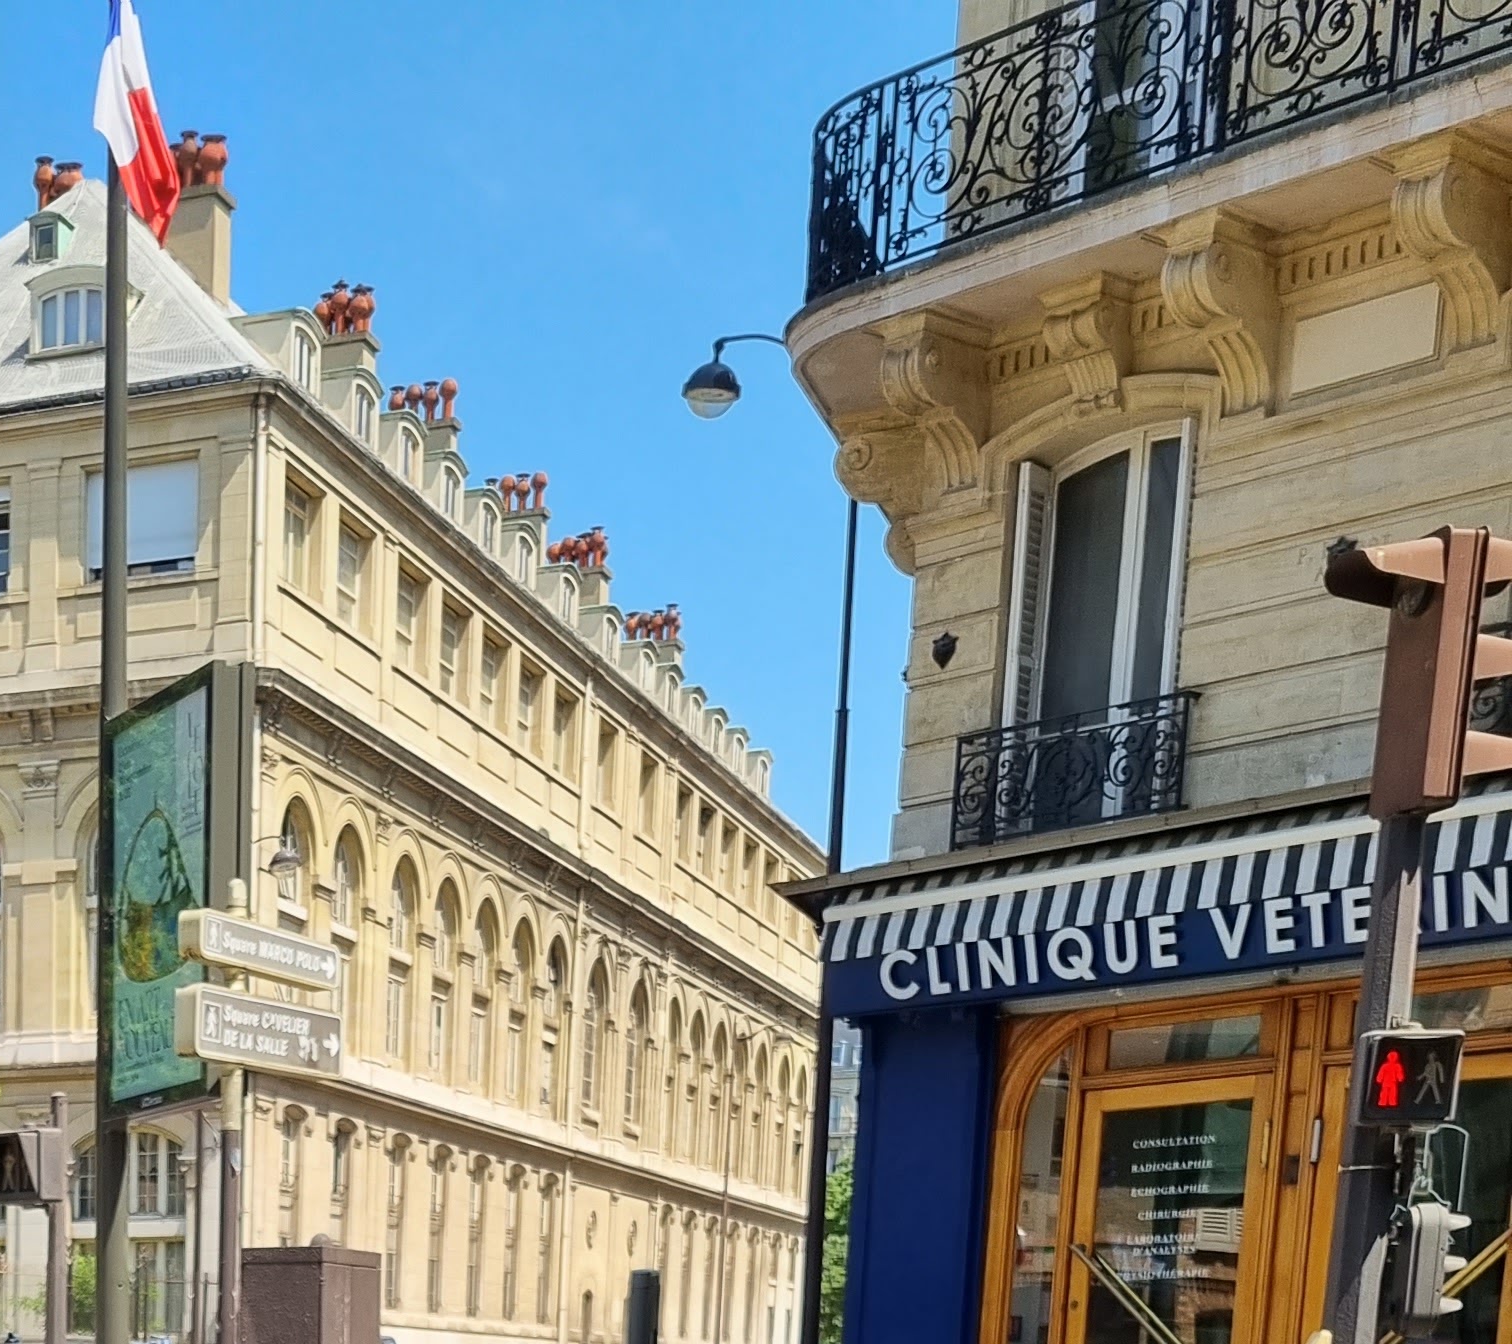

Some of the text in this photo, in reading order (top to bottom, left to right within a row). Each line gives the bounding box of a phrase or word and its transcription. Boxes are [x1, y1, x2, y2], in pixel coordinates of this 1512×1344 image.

[879, 866, 1509, 1000] CLINIQUE VETEIN
[222, 931, 321, 972] Square MARCO POLO
[223, 1004, 260, 1027] Square
[223, 1028, 289, 1057] DE LA SALLE
[1132, 1135, 1217, 1150] CONSULTATION
[1131, 1159, 1214, 1174] RADIOGRAPHIE
